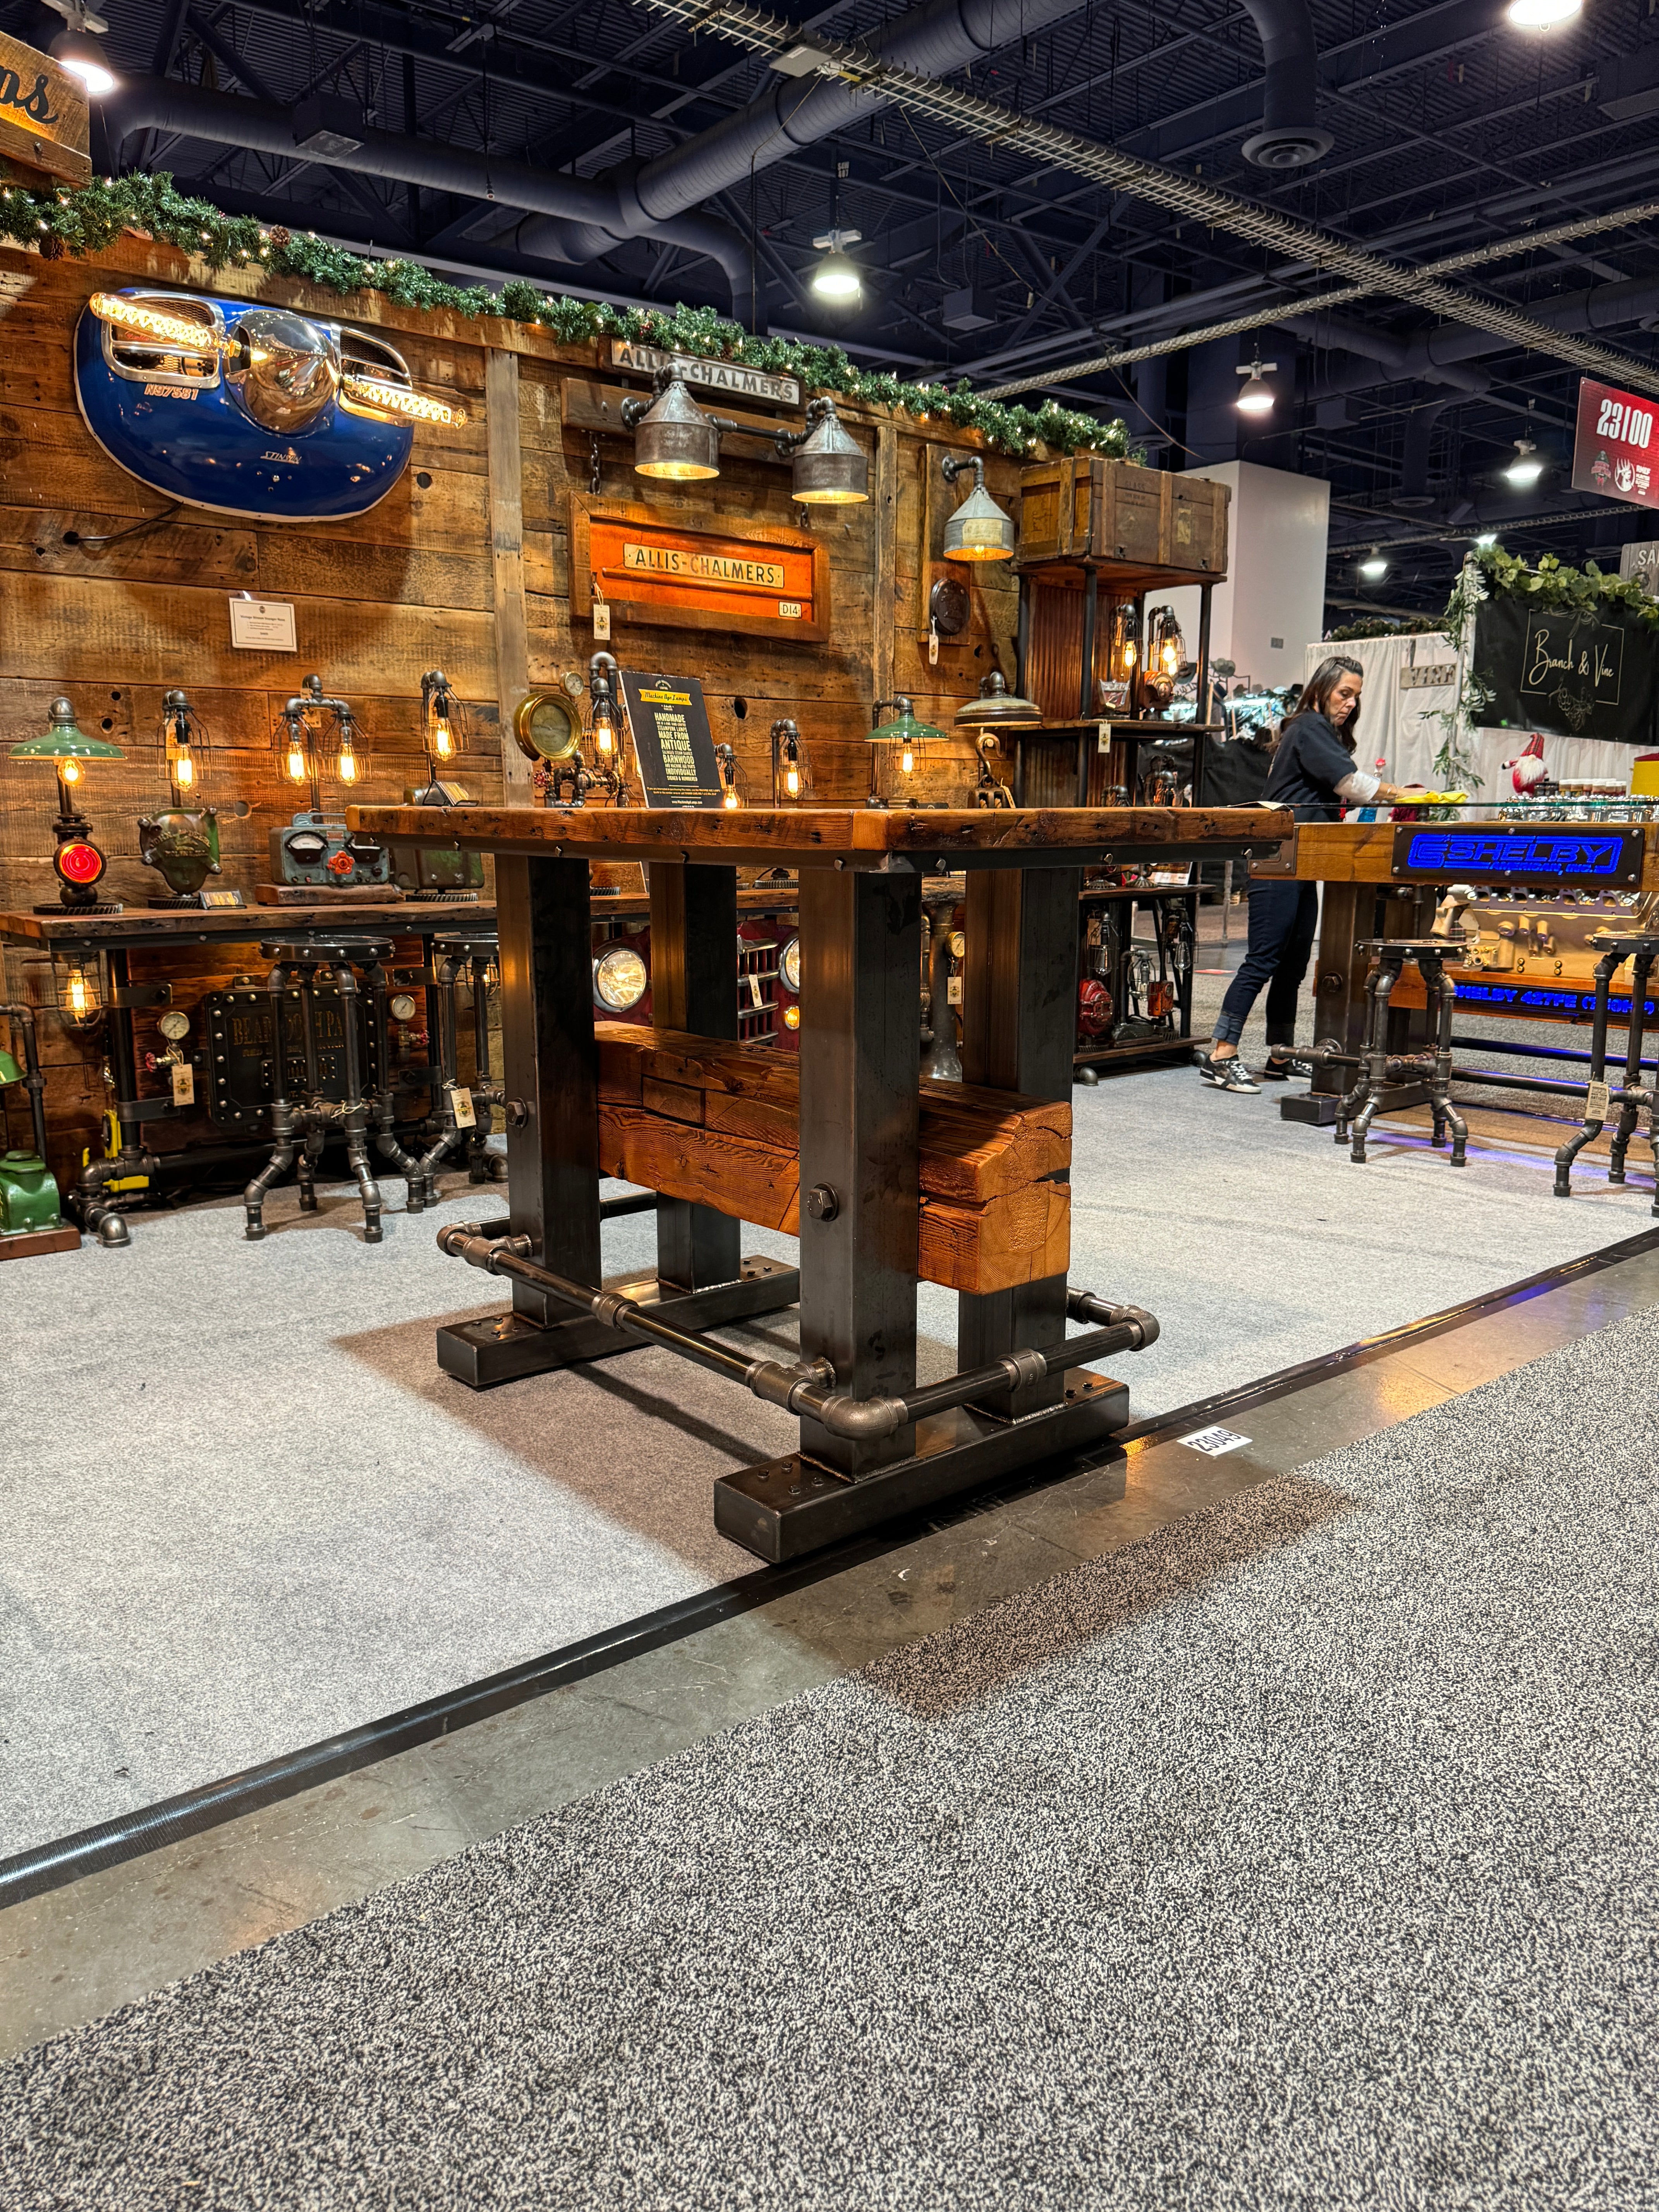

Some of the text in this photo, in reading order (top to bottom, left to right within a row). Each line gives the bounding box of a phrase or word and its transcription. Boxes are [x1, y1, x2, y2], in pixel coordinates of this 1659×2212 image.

[620, 348, 793, 399] ALLI-CHALMERS
[144, 383, 199, 401] N97581
[1596, 399, 1653, 448] 23100
[1638, 549, 1659, 565] SA
[635, 549, 774, 583] ALLIS-CHALMERS
[783, 604, 798, 615] D14
[1529, 629, 1614, 687] Branch & Vine
[654, 712, 686, 723] HANDMADE
[658, 730, 689, 740] MADE FROM
[661, 738, 692, 751] ANTIQUE
[663, 754, 695, 764] BARNWOOD
[665, 768, 696, 776] INDIVIDUALLY
[149, 831, 173, 848] JOHN
[1447, 842, 1613, 863] SHELBY
[1489, 861, 1593, 876] AMERICAN, INC.
[1520, 991, 1577, 1008] 427FE
[1187, 1430, 1242, 1452] 23049
